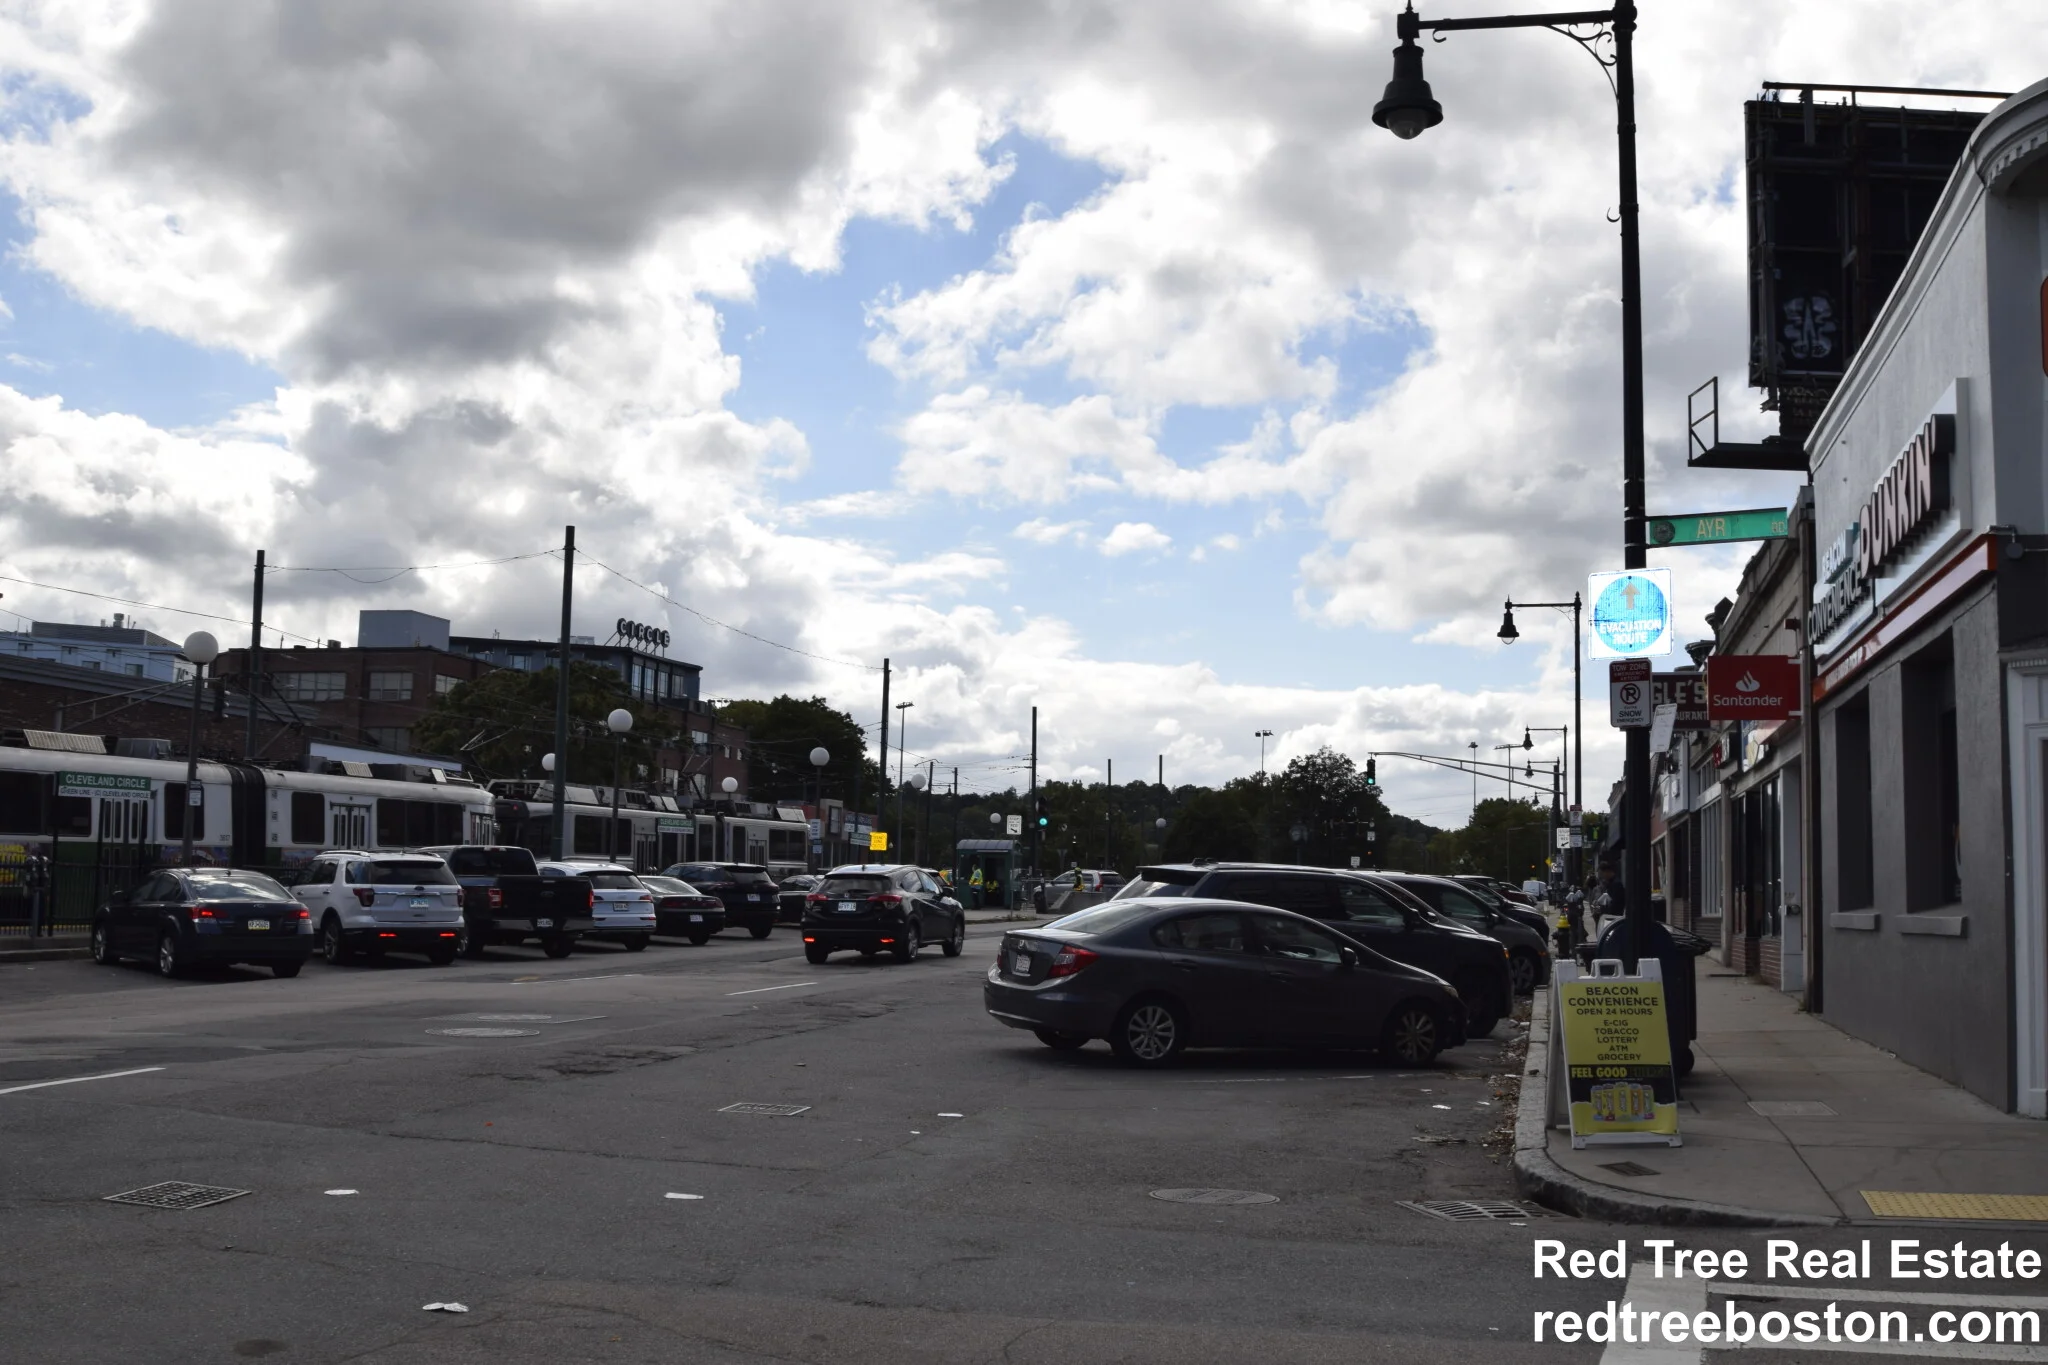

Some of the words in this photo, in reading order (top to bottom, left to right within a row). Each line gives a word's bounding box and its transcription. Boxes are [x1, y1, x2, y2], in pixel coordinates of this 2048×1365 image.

[1859, 414, 1939, 579] DUNKIN'
[1696, 517, 1726, 539] AYR
[1807, 561, 1862, 645] CONVENIENCE
[1600, 620, 1662, 634] EVACUATION
[619, 619, 671, 647] CIRCLE
[1613, 632, 1648, 645] ROUTE
[1652, 679, 1707, 705] GLE'S
[1712, 694, 1784, 707] Santander
[1676, 710, 1707, 721] AURANT
[66, 774, 115, 787] CLEVELAND
[116, 777, 146, 788] CIRCLE
[103, 790, 132, 798] CLEVELAND
[132, 791, 150, 799] CIRCLE
[1585, 986, 1639, 996] BEACON
[1568, 997, 1659, 1007] CONVENIENCE
[1576, 1008, 1603, 1016] OPEN
[1620, 1008, 1653, 1016] HOURS
[1603, 1019, 1629, 1027] E-CIG
[1594, 1027, 1639, 1035] TOBACCO
[1597, 1036, 1638, 1044] LOTTERY
[1597, 1053, 1642, 1061] GROCERY
[1571, 1067, 1594, 1078] FEEL
[1596, 1067, 1628, 1078] GOOD
